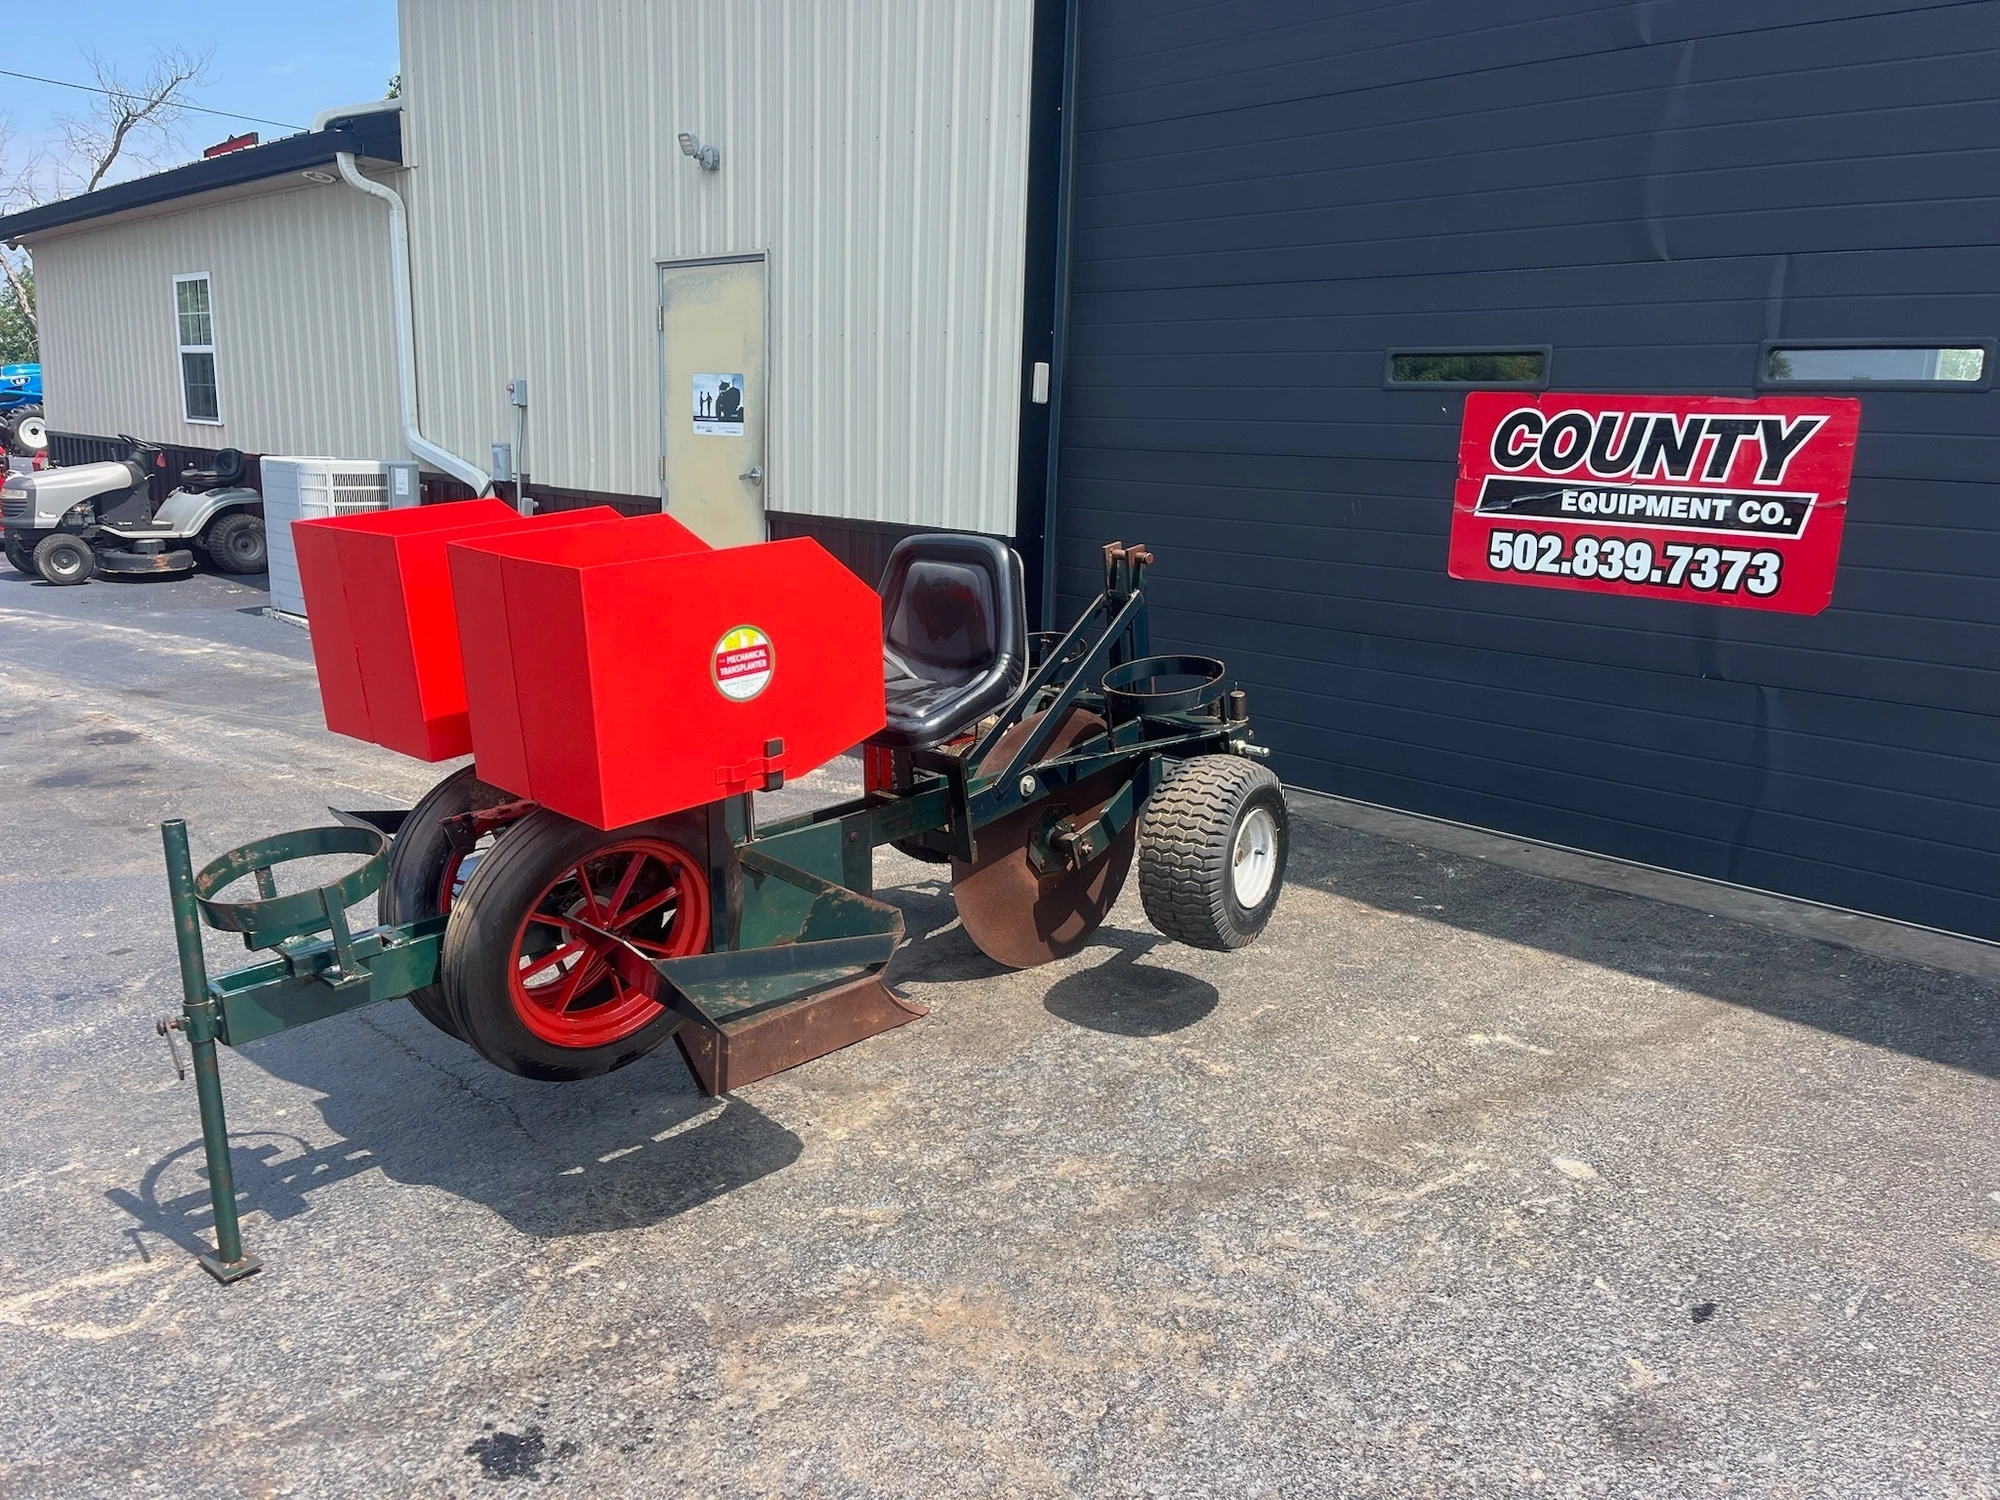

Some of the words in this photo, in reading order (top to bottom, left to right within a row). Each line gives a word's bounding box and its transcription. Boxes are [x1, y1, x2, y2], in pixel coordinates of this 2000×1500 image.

[1490, 407, 1830, 485] COUNTY
[1560, 488, 1733, 521] EQUIPMENT
[1737, 501, 1792, 526] CO.
[1488, 530, 1781, 596] 502.839.7373
[719, 659, 768, 677] TRANSPLANTER
[726, 649, 767, 665] MECHANICAL
